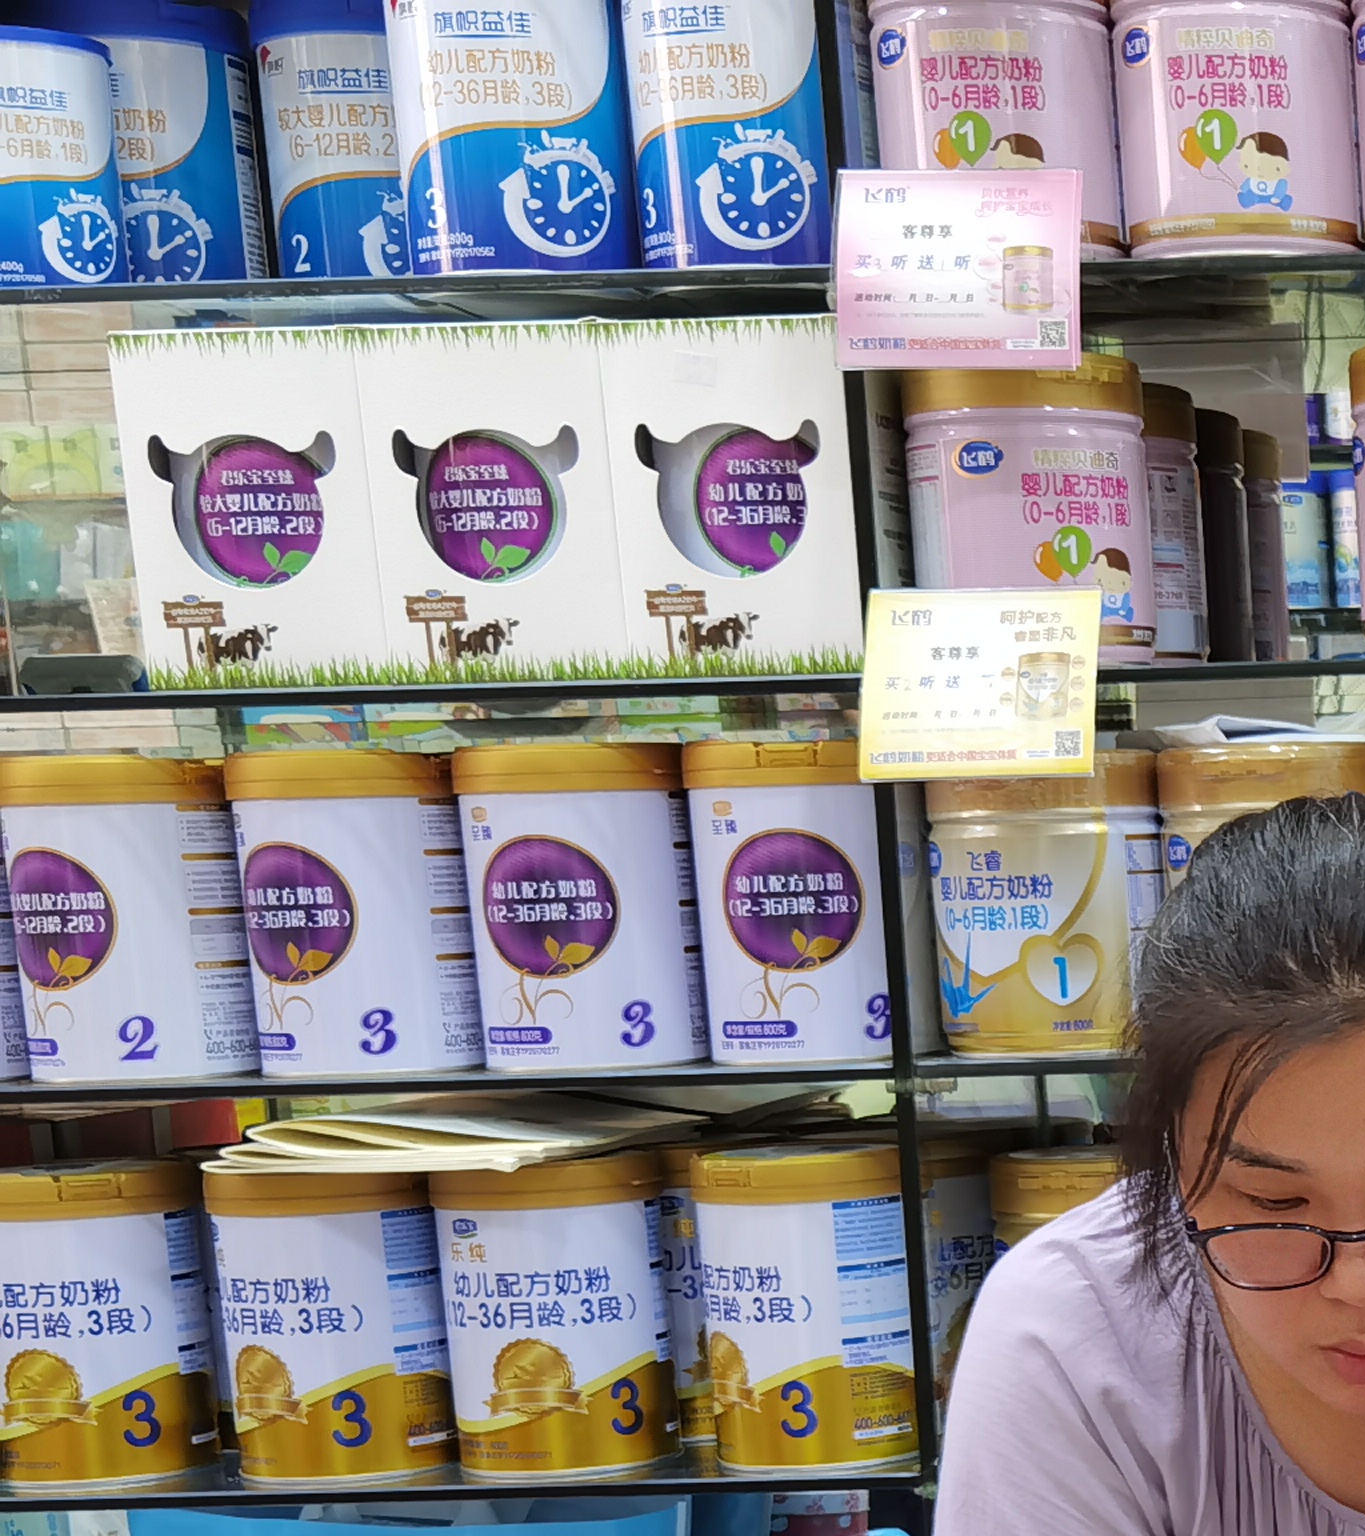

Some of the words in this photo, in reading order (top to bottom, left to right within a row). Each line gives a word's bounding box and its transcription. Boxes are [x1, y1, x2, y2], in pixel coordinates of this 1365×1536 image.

[428, 49, 556, 75] 幼儿配方奶粉
[920, 55, 1043, 81] 婴儿配方奶粉
[1167, 55, 1289, 81] 婴儿配方奶粉
[956, 121, 978, 152] 1
[1204, 119, 1222, 150] 1
[425, 188, 448, 229] 3
[1021, 473, 1129, 500] 婴儿配方奶粉
[1063, 534, 1079, 565] 1
[940, 875, 1053, 901] 婴儿配方奶粉
[1052, 956, 1070, 999] 1
[117, 1015, 160, 1062] 2
[359, 1008, 398, 1056] 3
[620, 1000, 656, 1047] 3
[453, 1265, 612, 1299] 幼儿配方奶粉
[121, 1389, 162, 1448] 3
[331, 1389, 373, 1448] 3
[610, 1378, 645, 1436] 3
[780, 1379, 819, 1439] 3
